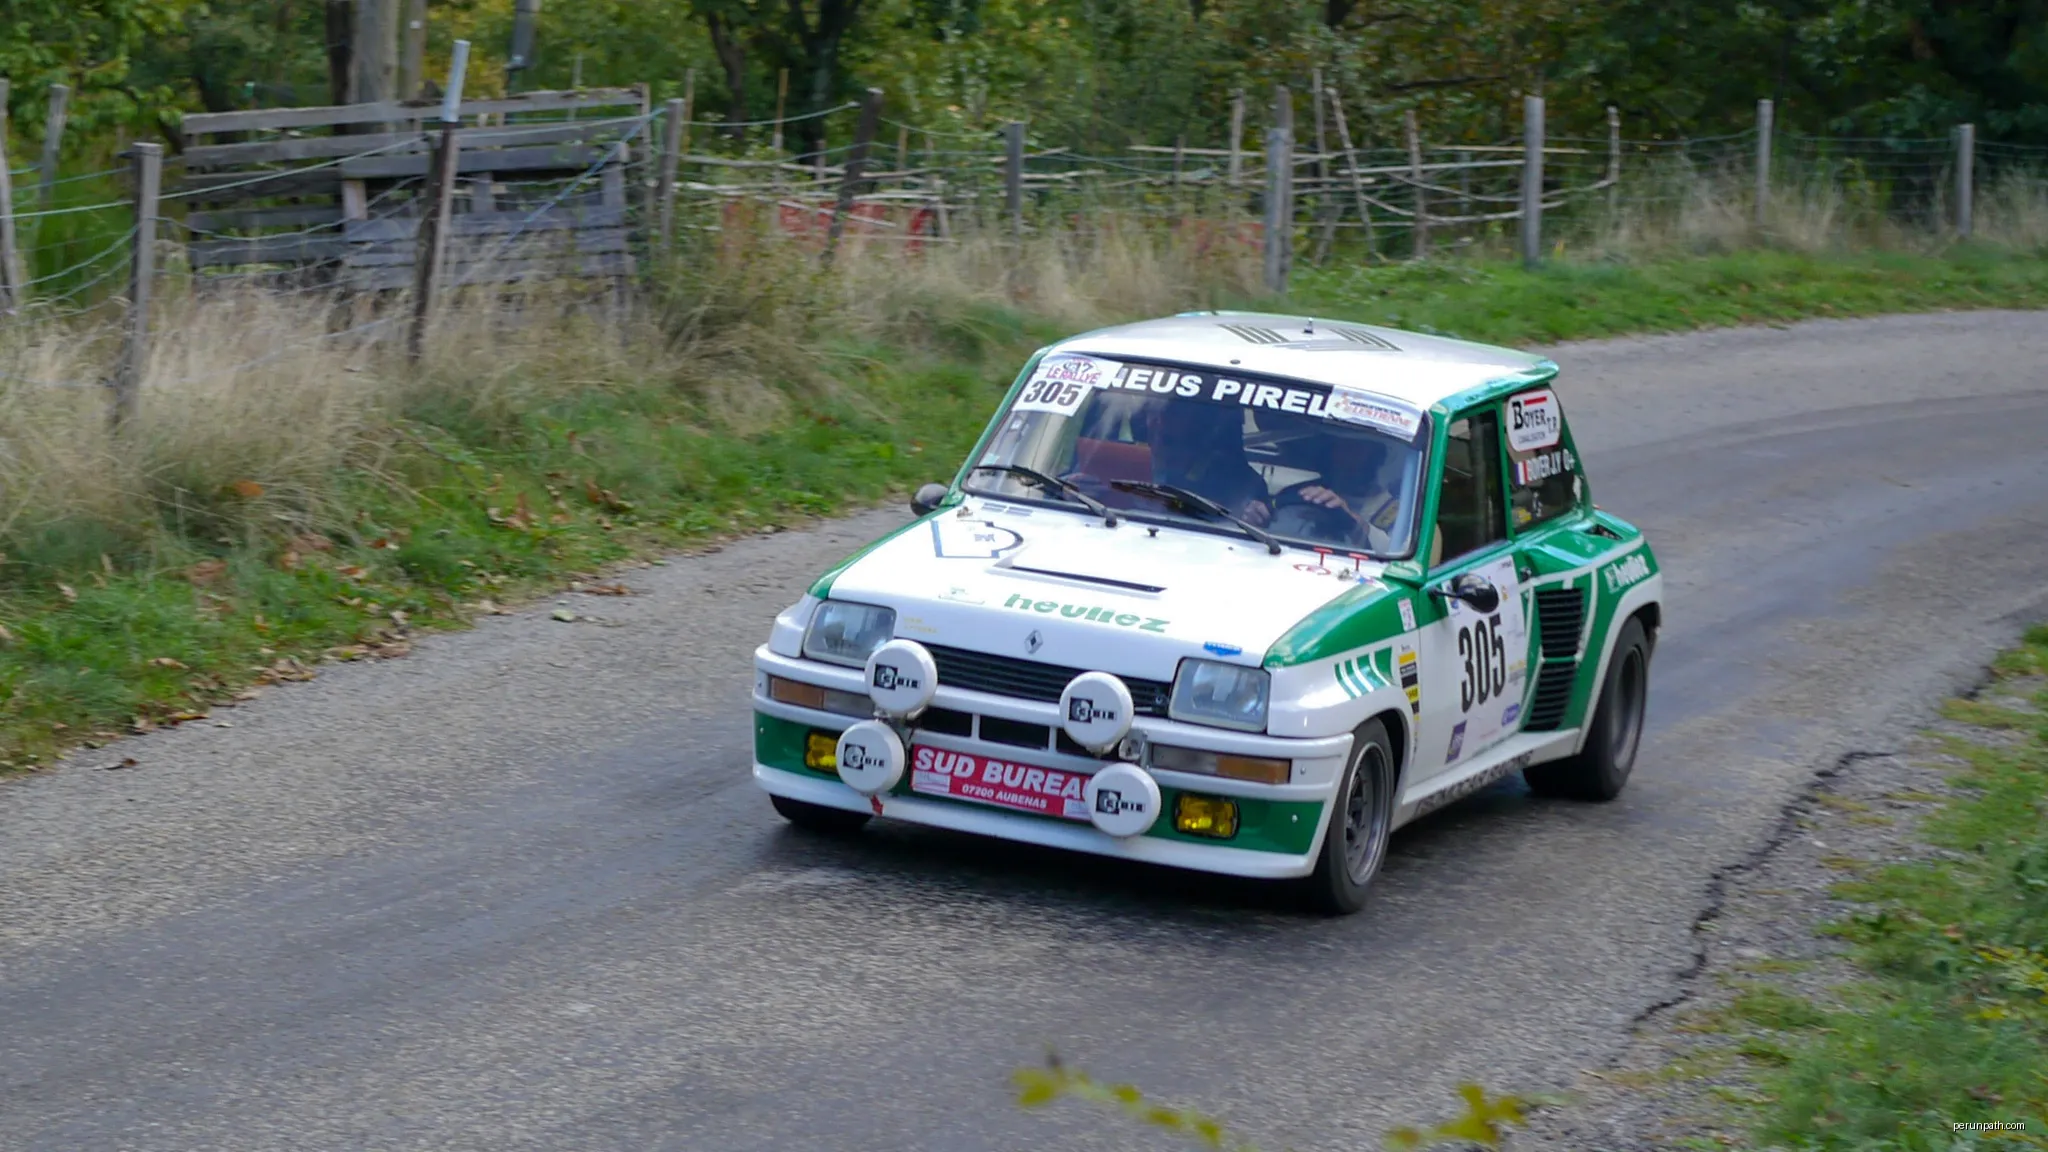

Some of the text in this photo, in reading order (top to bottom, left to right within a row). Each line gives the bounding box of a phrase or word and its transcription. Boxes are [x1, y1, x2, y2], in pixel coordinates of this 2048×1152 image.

[1046, 365, 1061, 379] LE
[1061, 371, 1102, 385] RALLYE
[1024, 380, 1083, 406] 305
[1511, 401, 1546, 430] BOYER
[1003, 593, 1171, 633] heuliez
[1458, 612, 1506, 713] 305
[914, 748, 976, 778] SUD
[962, 783, 1048, 809] 07200 AUBENAS
